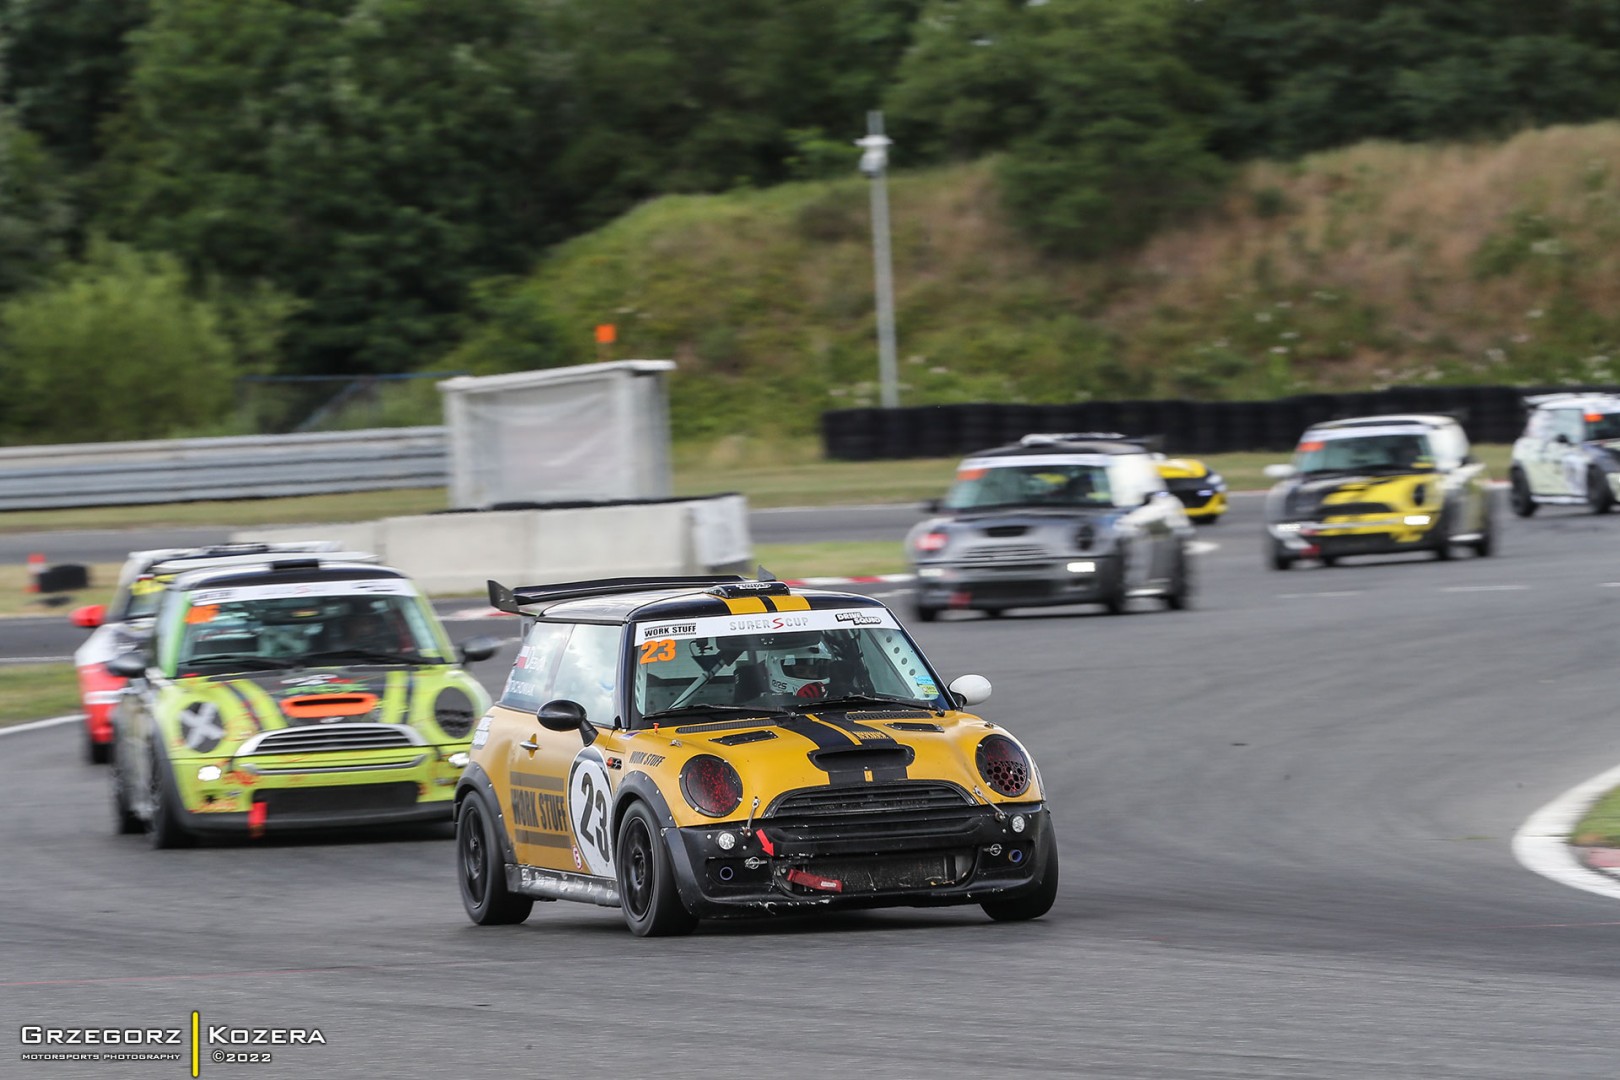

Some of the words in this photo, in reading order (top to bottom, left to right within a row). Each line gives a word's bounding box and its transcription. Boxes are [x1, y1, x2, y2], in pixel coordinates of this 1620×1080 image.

[644, 626, 669, 637] WORK
[672, 625, 697, 634] STUFF
[640, 638, 677, 664] 23
[643, 753, 666, 767] STUFF
[511, 788, 539, 828] WORK
[538, 793, 568, 832] STUFF
[580, 772, 610, 863] 23
